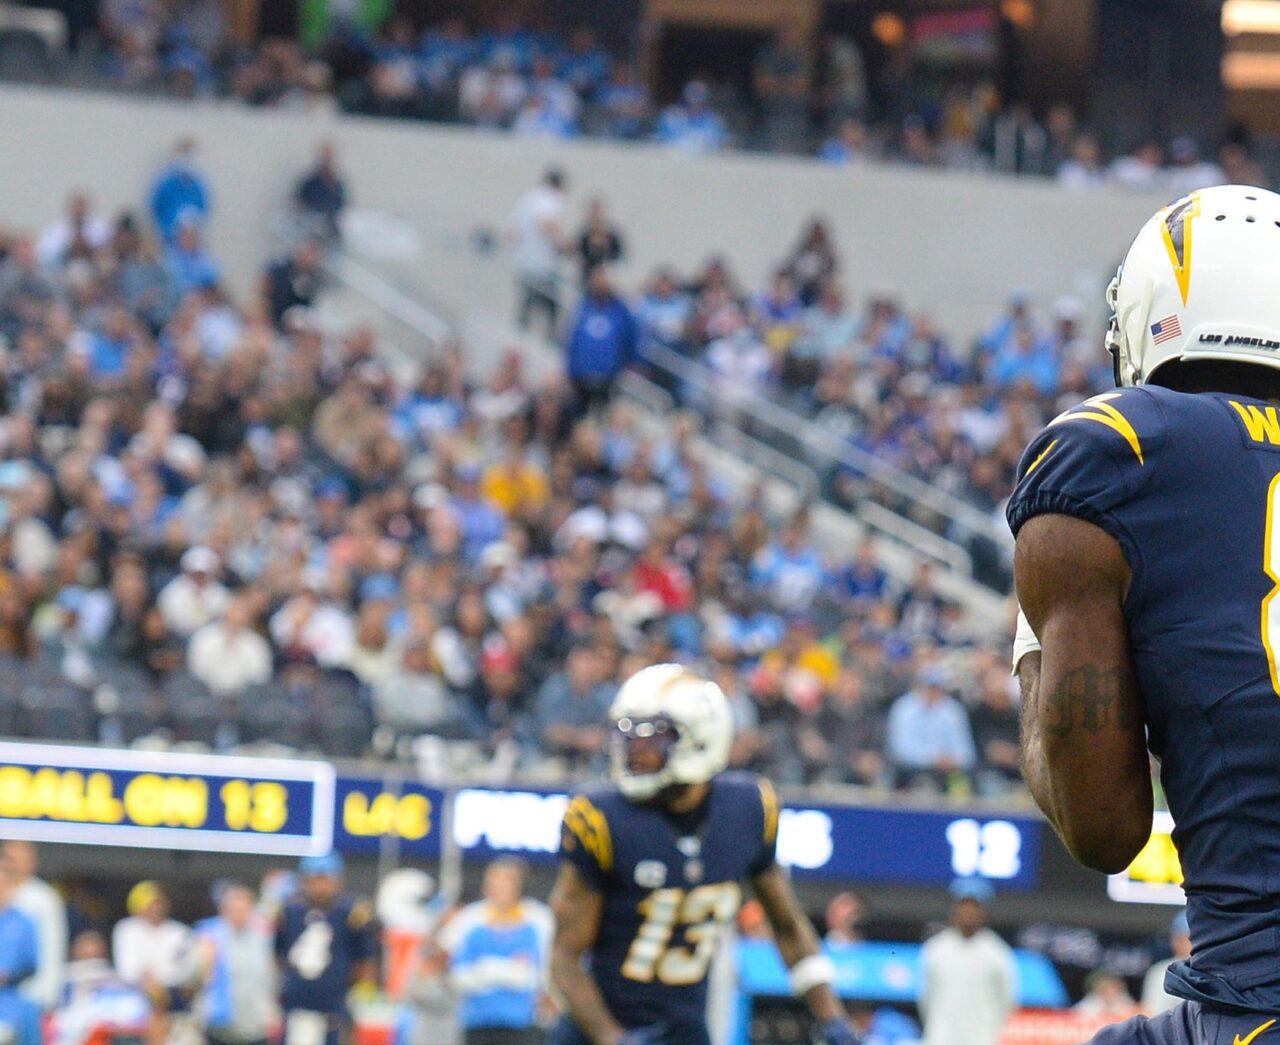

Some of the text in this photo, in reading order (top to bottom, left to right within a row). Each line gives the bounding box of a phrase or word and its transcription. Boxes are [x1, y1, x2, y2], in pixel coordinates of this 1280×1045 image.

[1199, 334, 1222, 343] LOS
[124, 773, 209, 828] ON
[620, 880, 742, 985] 13
